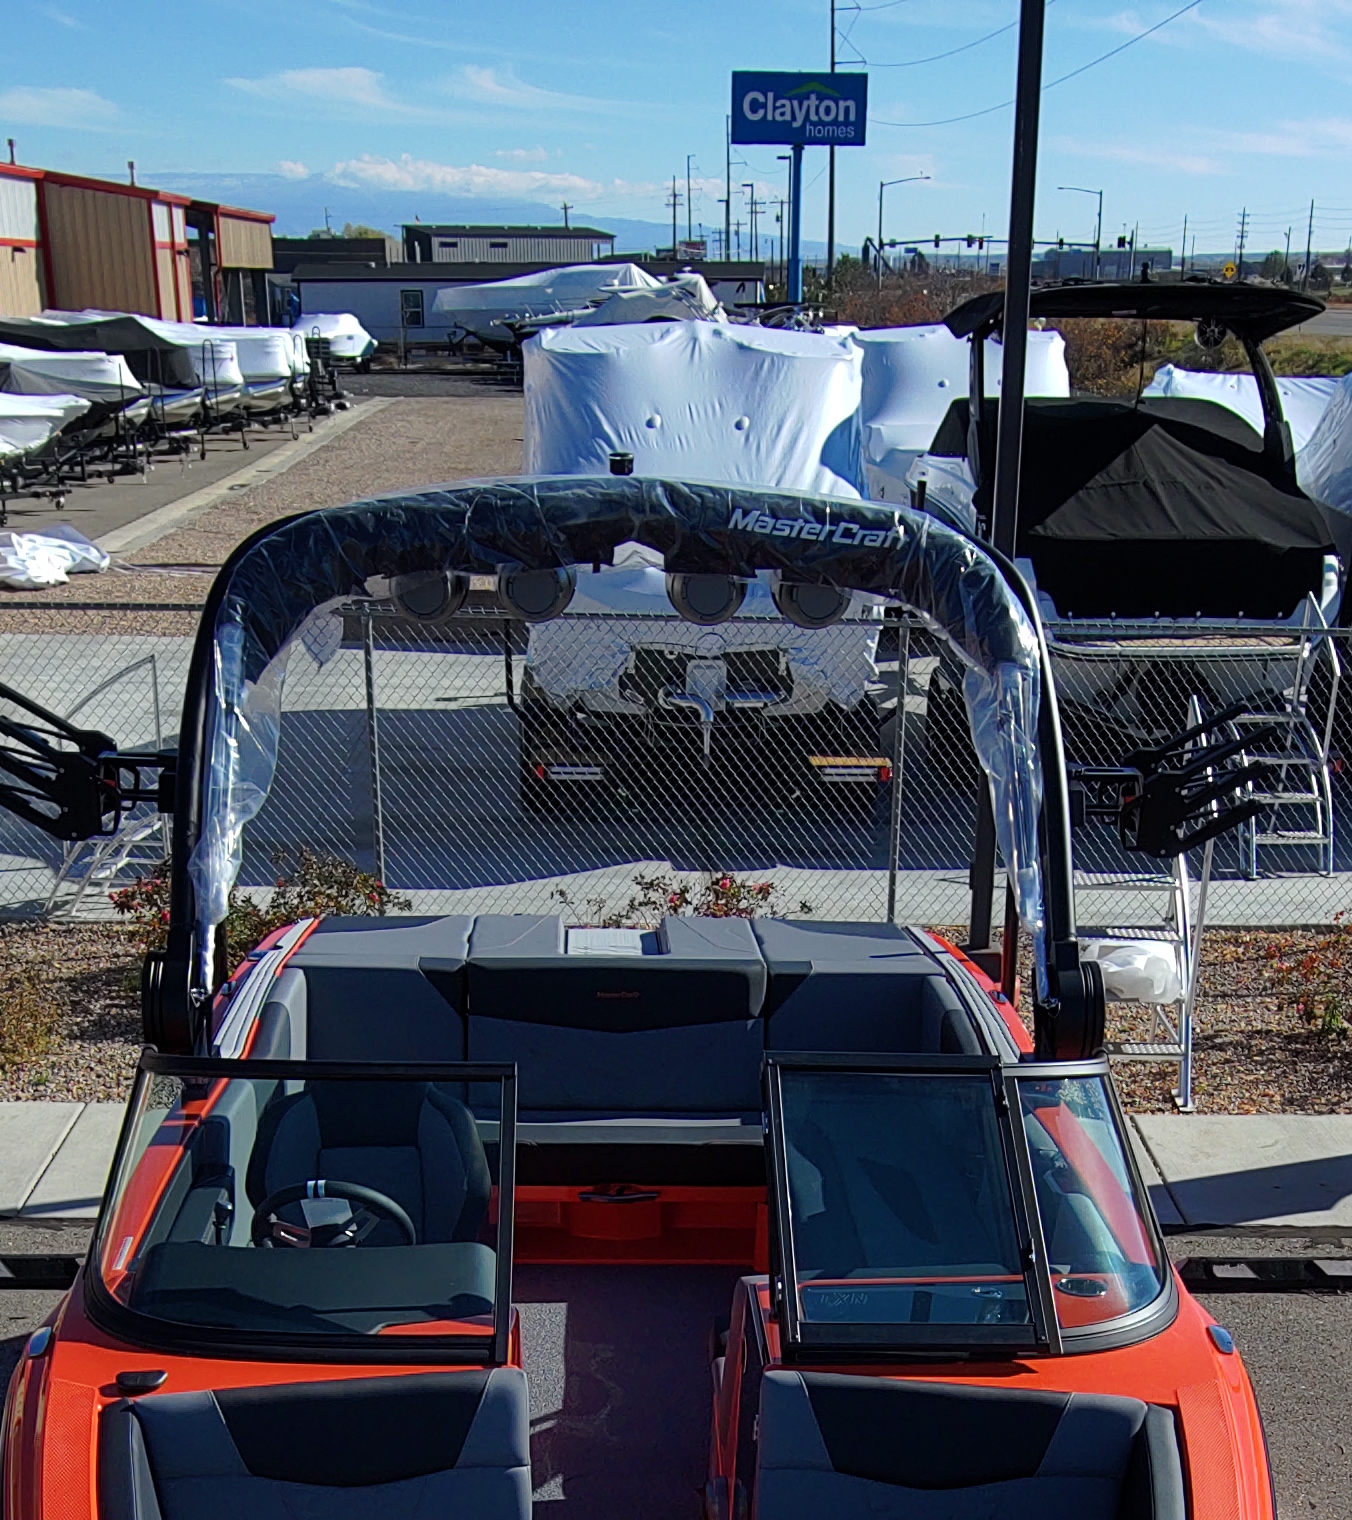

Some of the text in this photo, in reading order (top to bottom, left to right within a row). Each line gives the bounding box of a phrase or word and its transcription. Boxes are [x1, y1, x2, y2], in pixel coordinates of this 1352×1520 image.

[743, 91, 856, 128] Clayton
[805, 122, 855, 138] homes
[728, 508, 910, 550] MasterCraft
